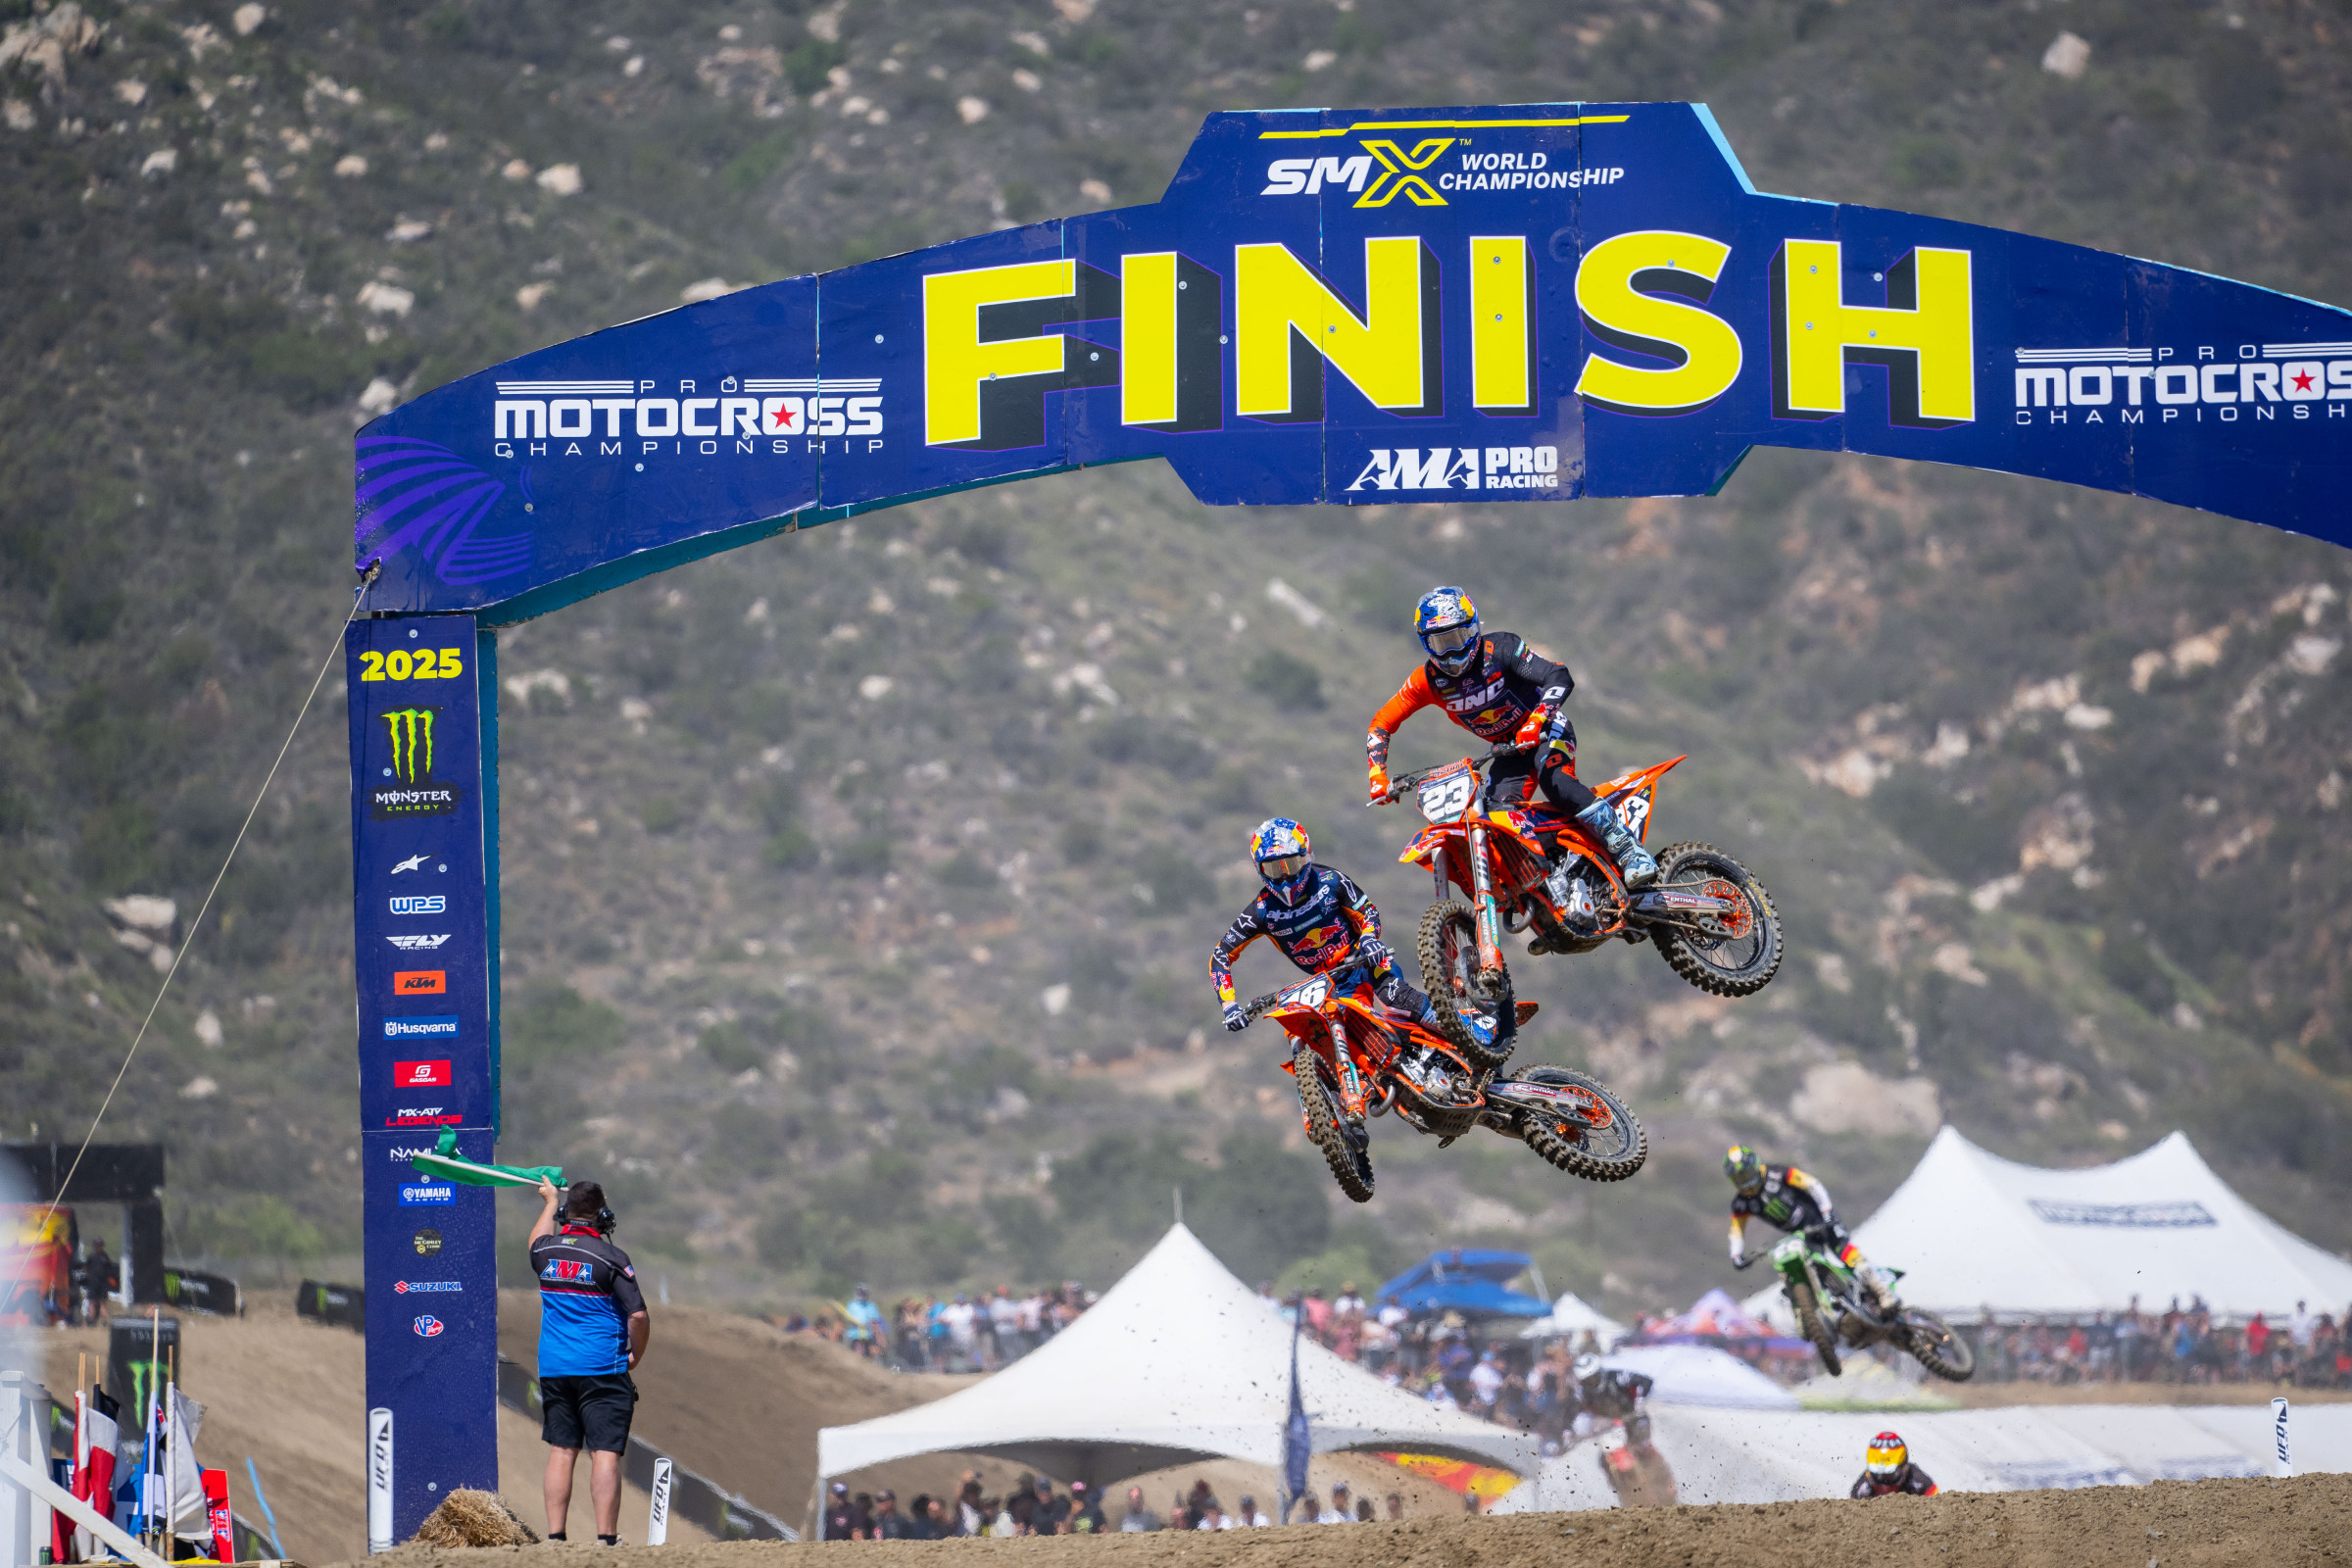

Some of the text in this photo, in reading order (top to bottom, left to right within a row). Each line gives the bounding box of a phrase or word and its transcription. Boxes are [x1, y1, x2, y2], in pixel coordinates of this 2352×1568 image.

[1461, 153, 1547, 172] WORLD
[1260, 138, 1456, 208] SMX
[1439, 167, 1625, 191] CHAMPIONSHIP
[922, 229, 1977, 448] FINISH
[2158, 344, 2258, 362] PRO
[639, 378, 739, 394] PRO
[494, 397, 883, 439] MOTOCROSS
[494, 439, 883, 456] CHAMPIONSHIP
[1345, 448, 1480, 491] AMA
[1485, 446, 1558, 474] PRO
[1486, 473, 1558, 489] RACING
[359, 648, 463, 682] 2025
[1475, 707, 1524, 735] Red Bull
[375, 790, 452, 805] MONSTER
[1422, 775, 1470, 822] 23
[390, 896, 446, 914] WPS
[388, 934, 452, 947] FLY
[1295, 948, 1326, 965] Red
[404, 977, 436, 989] KTM
[397, 1022, 456, 1035] Husqvarna
[385, 1114, 463, 1126] LEGENDS
[397, 1107, 443, 1117] MX-ATV
[415, 1188, 452, 1198] YAMAHA
[540, 1258, 593, 1282] AMA
[410, 1281, 462, 1292] SUZUKI
[415, 1315, 435, 1336] VP
[2276, 1423, 2287, 1463] UFO
[373, 1447, 386, 1492] UFO
[652, 1489, 665, 1525] UFO
